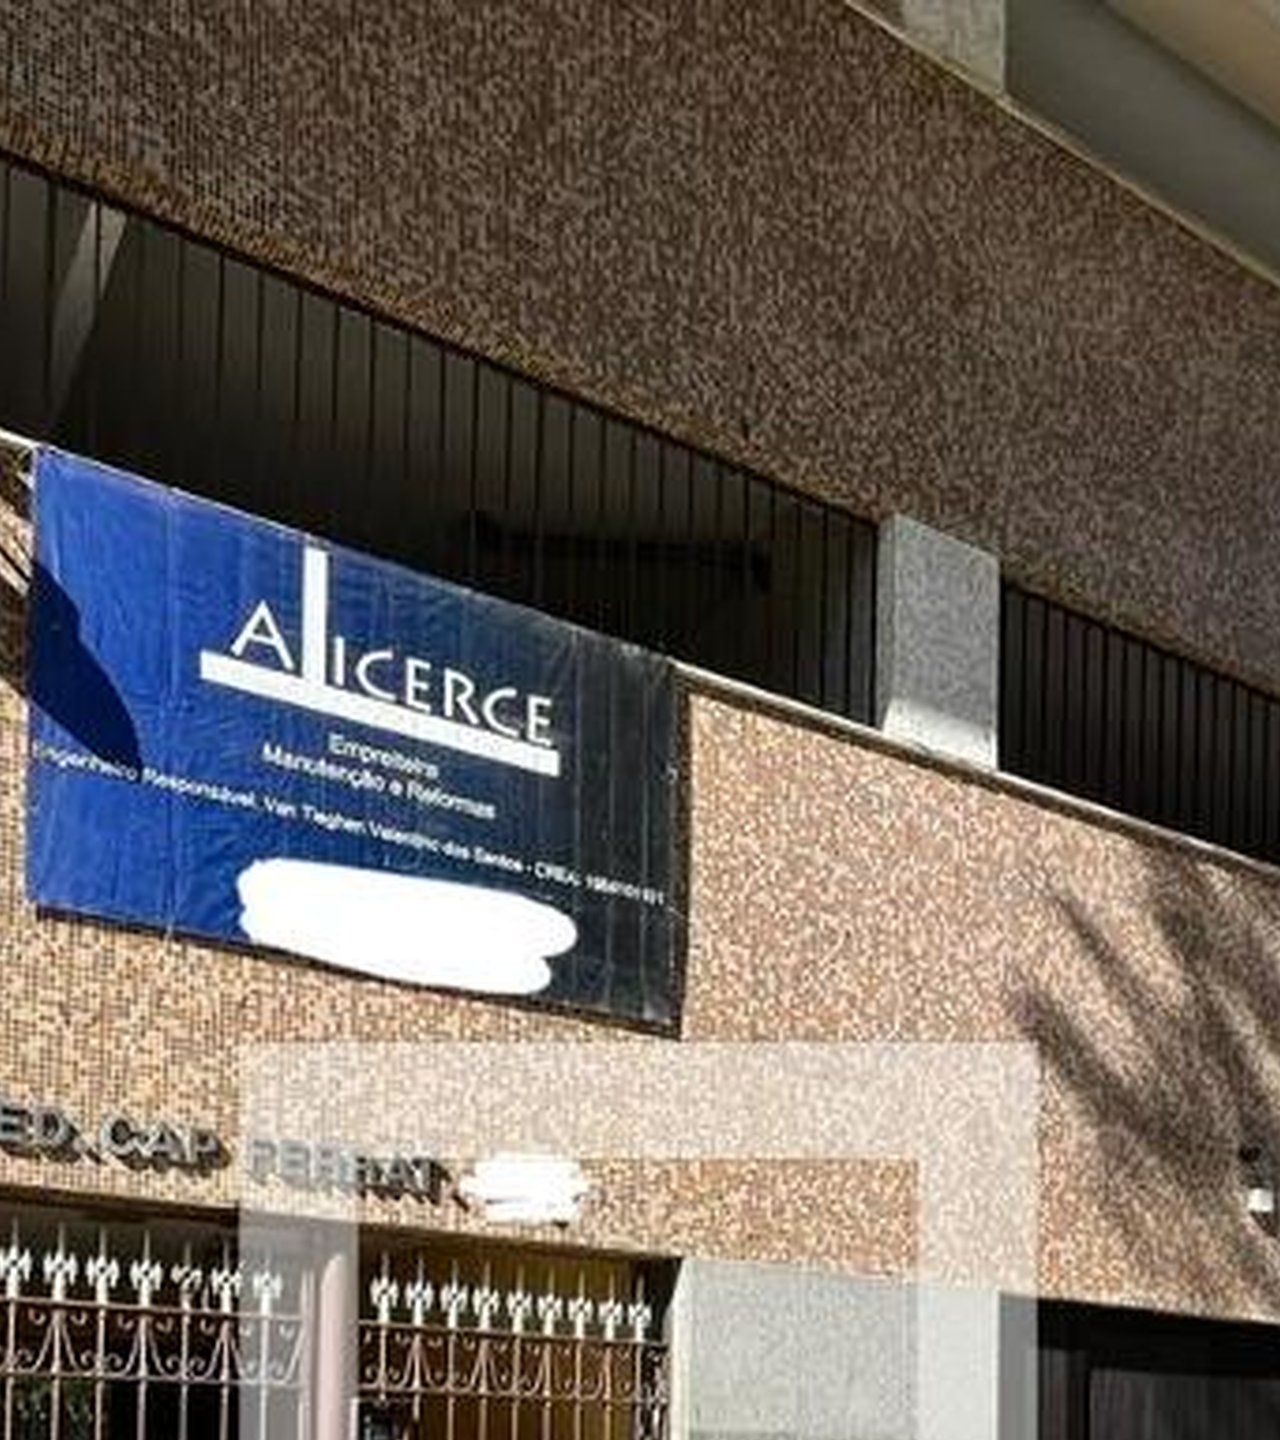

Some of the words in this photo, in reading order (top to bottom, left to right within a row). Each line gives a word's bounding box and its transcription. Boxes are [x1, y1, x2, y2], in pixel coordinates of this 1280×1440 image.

[262, 741, 386, 794] Manutenção
[389, 780, 404, 797] e
[407, 781, 497, 821] Reformas
[328, 732, 440, 780] Empreiteira
[264, 796, 297, 818] Van
[442, 841, 471, 860] dos
[474, 846, 524, 873] Santos
[99, 1112, 233, 1175] CAP
